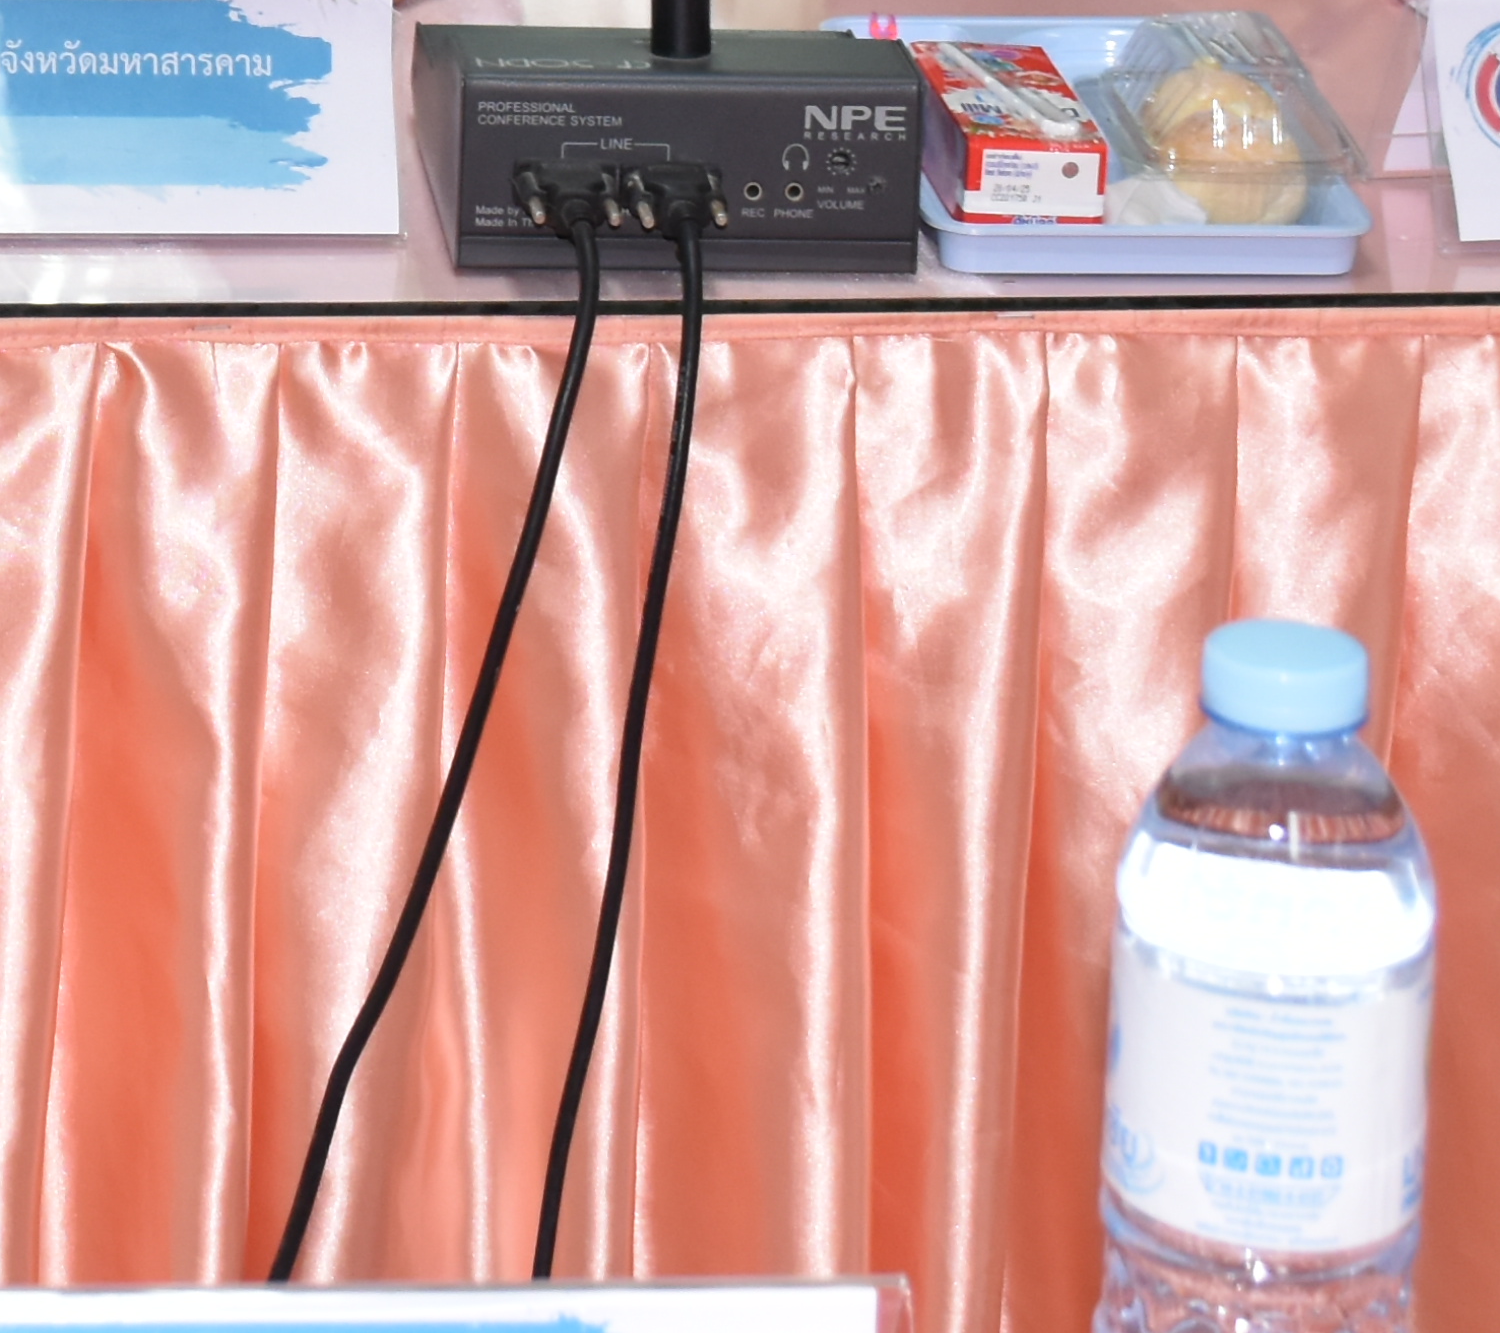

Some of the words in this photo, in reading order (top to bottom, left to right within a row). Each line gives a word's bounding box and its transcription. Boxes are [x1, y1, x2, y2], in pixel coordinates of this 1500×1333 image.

[477, 100, 577, 114] PROFESSIONAL
[477, 113, 566, 126] CONFERENCE
[570, 114, 623, 127] SYSTEM
[804, 104, 907, 132] NPE
[803, 131, 907, 142] RESEARCH
[600, 138, 634, 150] LINE
[816, 186, 835, 194] MIN
[846, 186, 866, 195] MAX
[816, 199, 865, 210] VOLUME
[475, 204, 505, 216] Made
[506, 205, 520, 218] by
[741, 207, 766, 219] REC
[773, 208, 814, 220] PHONE
[475, 216, 505, 228] Made
[506, 217, 518, 228] In
